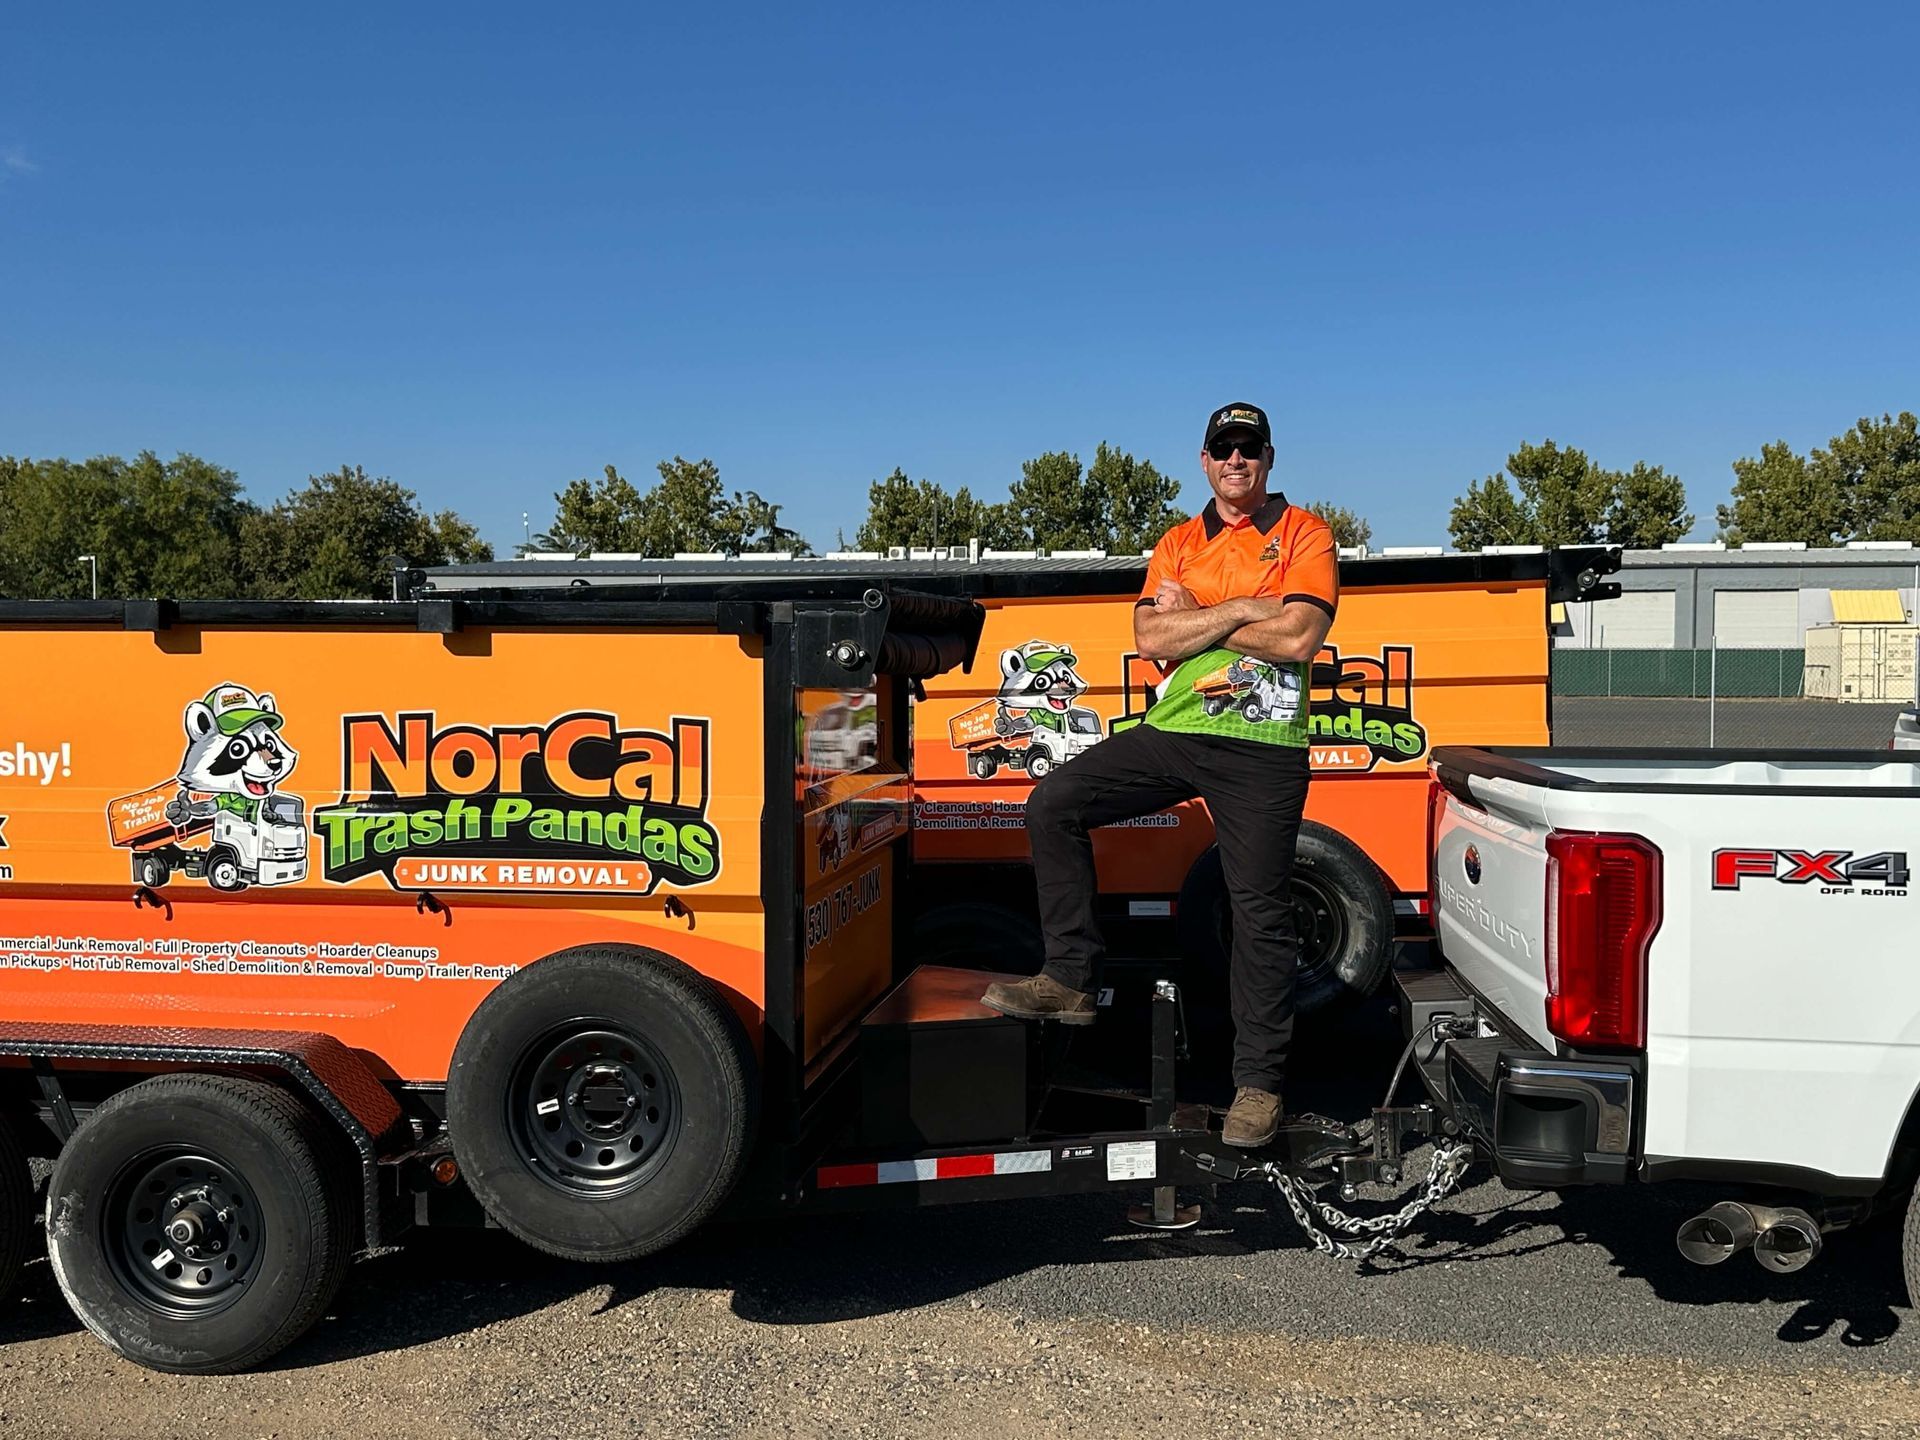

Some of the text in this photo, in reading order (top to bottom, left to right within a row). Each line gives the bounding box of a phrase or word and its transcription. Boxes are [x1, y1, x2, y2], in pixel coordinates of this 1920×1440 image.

[1308, 707, 1422, 755] ndas
[345, 714, 705, 809] NorCal
[121, 795, 165, 812] No Job
[129, 806, 153, 818] Too
[924, 802, 983, 814] Cleanouts
[994, 802, 1027, 813] Hoar
[122, 810, 161, 830] Trashy
[914, 818, 977, 829] Demolition
[980, 818, 989, 829] &
[991, 818, 1026, 829] Remo
[319, 798, 714, 877] Trash Pandas
[414, 864, 630, 886] JUNK REMOVAL
[1712, 848, 1910, 891] FX4
[1820, 887, 1908, 897] OFF ROAD
[804, 893, 833, 959] (530)
[1479, 905, 1537, 959] DUTY
[54, 938, 84, 951] Junk
[88, 939, 142, 952] Removal
[155, 941, 177, 953] Full
[182, 942, 237, 957] Property
[241, 943, 307, 956] Cleanouts
[319, 944, 372, 957] Hoarder
[376, 945, 437, 961] Cleanups
[12, 955, 60, 970] Pickups
[73, 957, 94, 969] Hot
[99, 957, 121, 970] Tub
[126, 959, 179, 971] Removal
[193, 960, 224, 972] Shed
[229, 961, 299, 974] Demolition
[303, 963, 312, 974] &
[317, 963, 372, 975] Removal
[386, 965, 424, 979] Dump
[428, 965, 470, 978] Trailer
[474, 965, 517, 978] Rental
